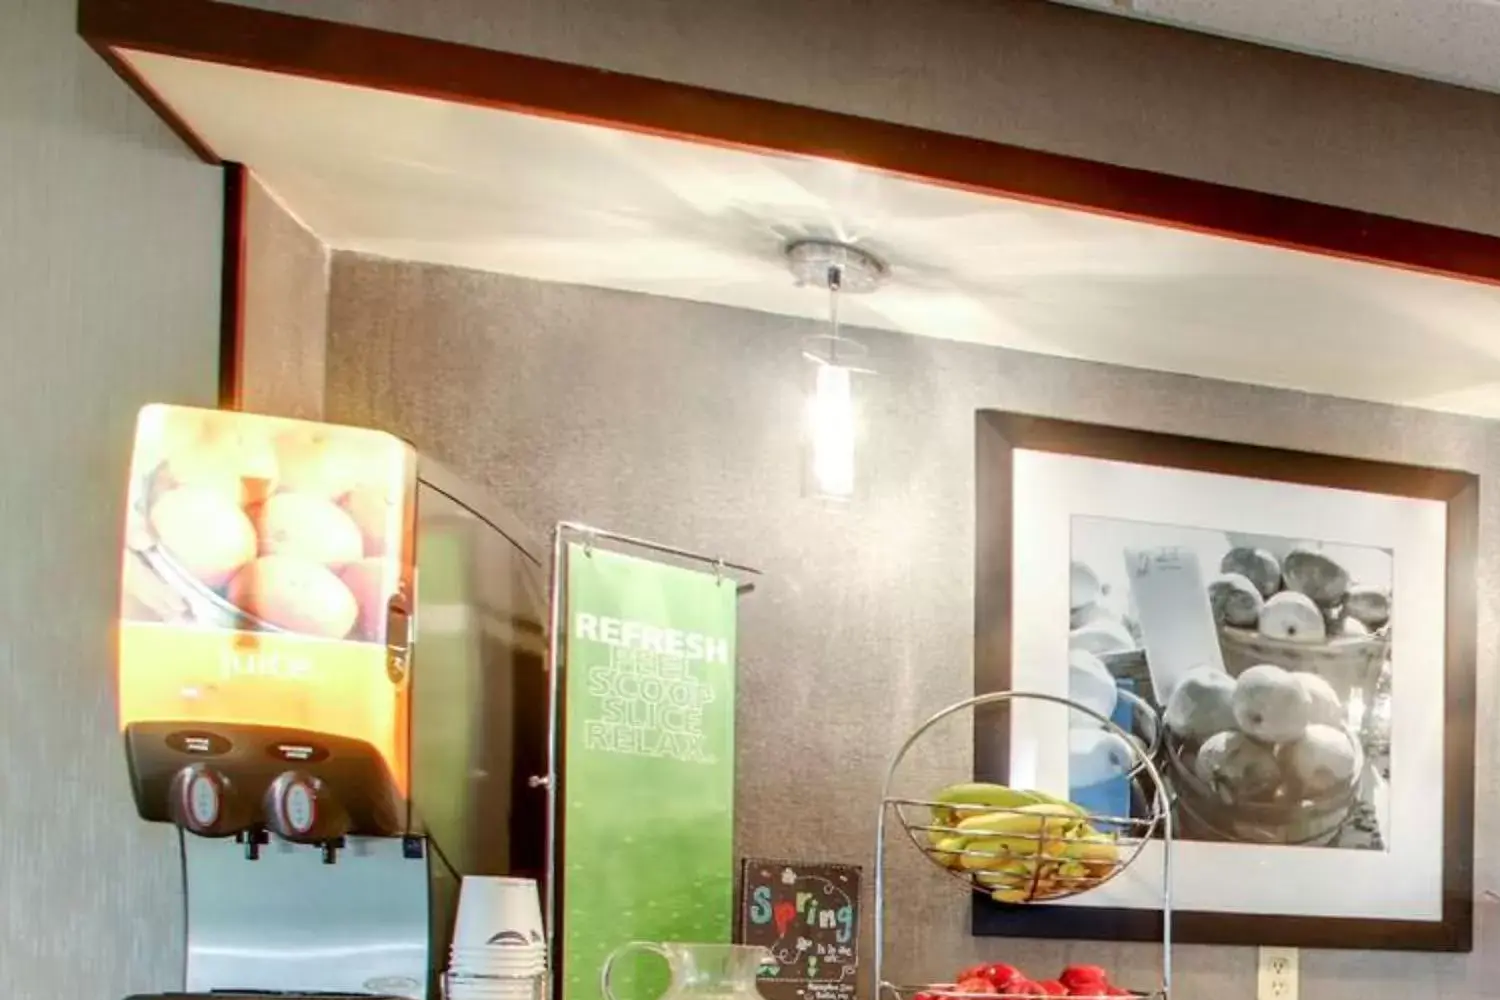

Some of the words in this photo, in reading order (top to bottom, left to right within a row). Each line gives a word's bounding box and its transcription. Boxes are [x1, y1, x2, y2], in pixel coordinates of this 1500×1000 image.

[576, 613, 728, 663] REFRESH
[589, 666, 716, 707] SCOOP
[601, 697, 704, 735] SLICE
[751, 886, 853, 943] Spring
